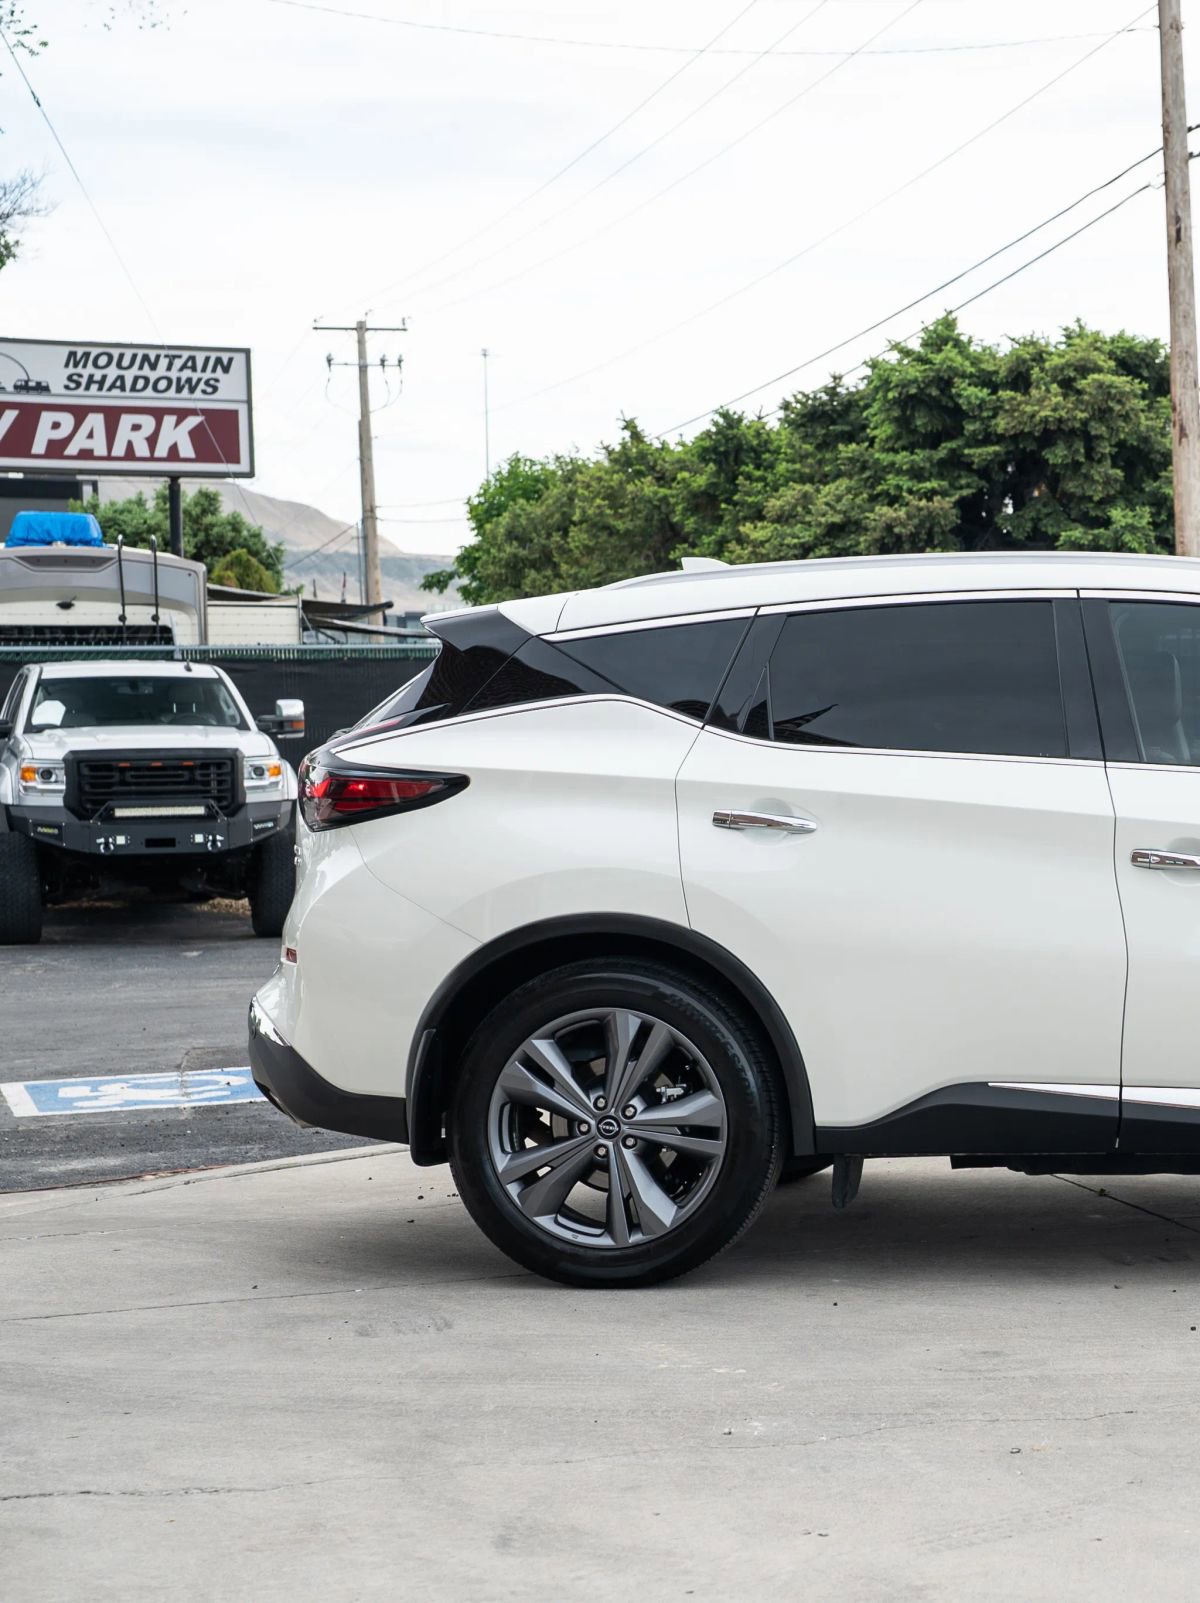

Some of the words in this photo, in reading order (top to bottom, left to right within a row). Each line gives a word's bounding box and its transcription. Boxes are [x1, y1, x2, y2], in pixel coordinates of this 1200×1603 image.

[63, 350, 234, 375] MOUNTAIN
[63, 372, 220, 396] SHADOWS
[31, 411, 205, 459] PARK
